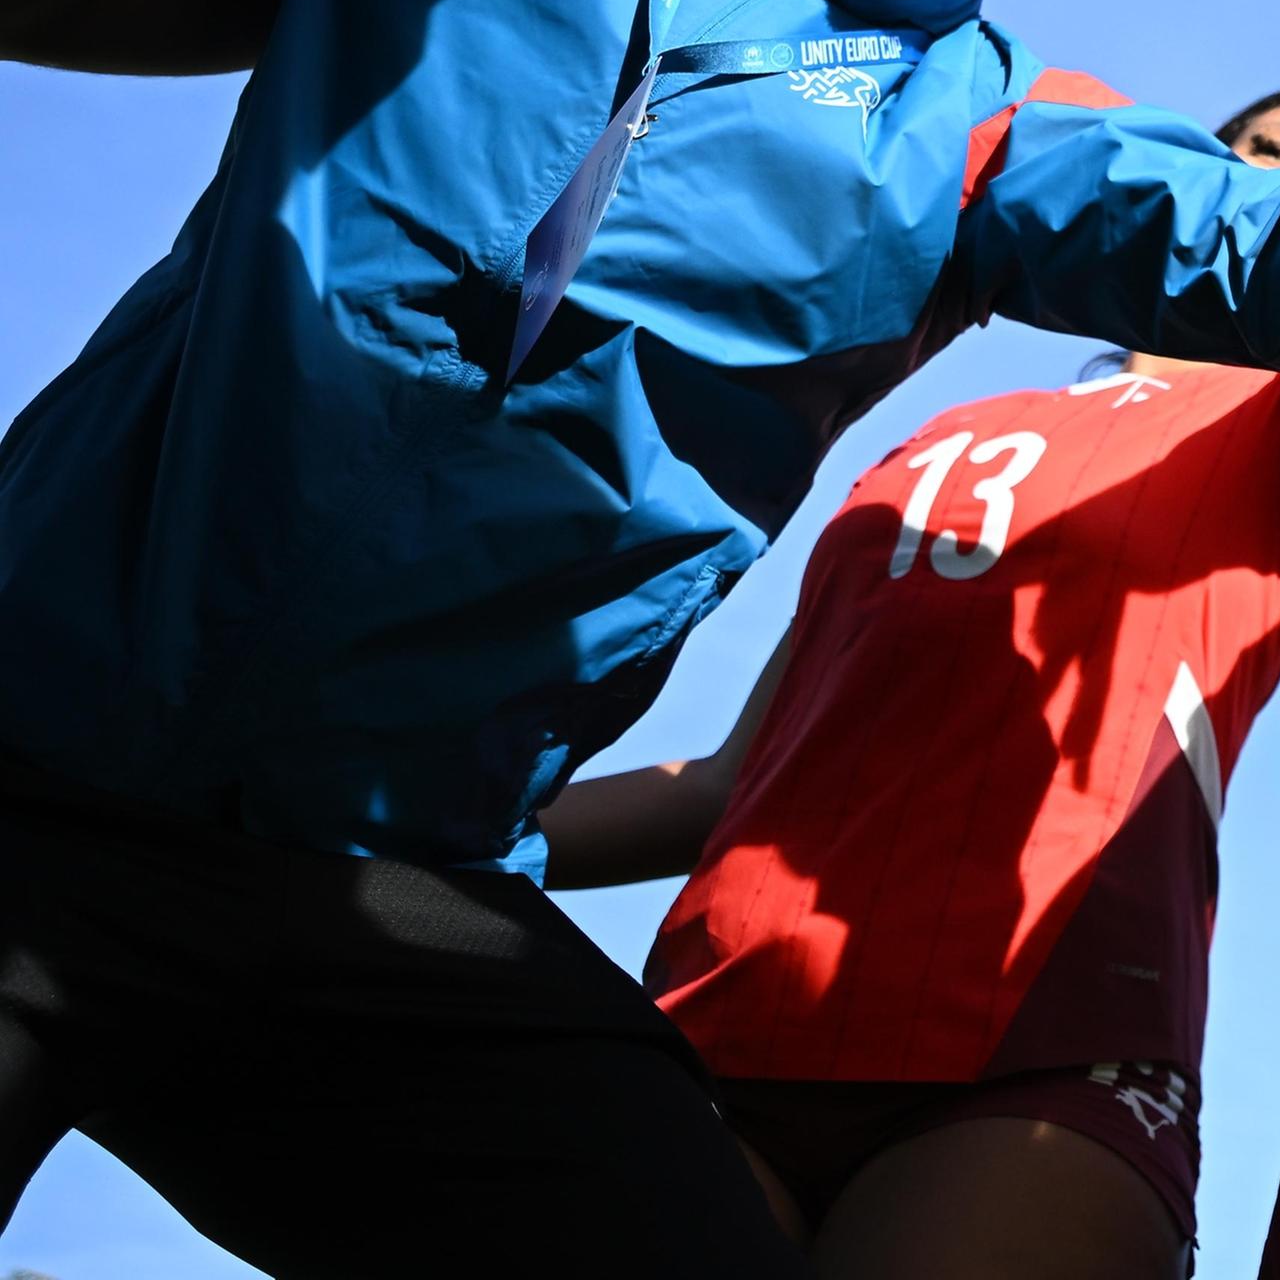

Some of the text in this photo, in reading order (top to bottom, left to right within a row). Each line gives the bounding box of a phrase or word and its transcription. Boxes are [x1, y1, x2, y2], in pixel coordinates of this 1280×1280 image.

[800, 35, 902, 66] UNITY EURO CUP
[889, 430, 1047, 580] 13
